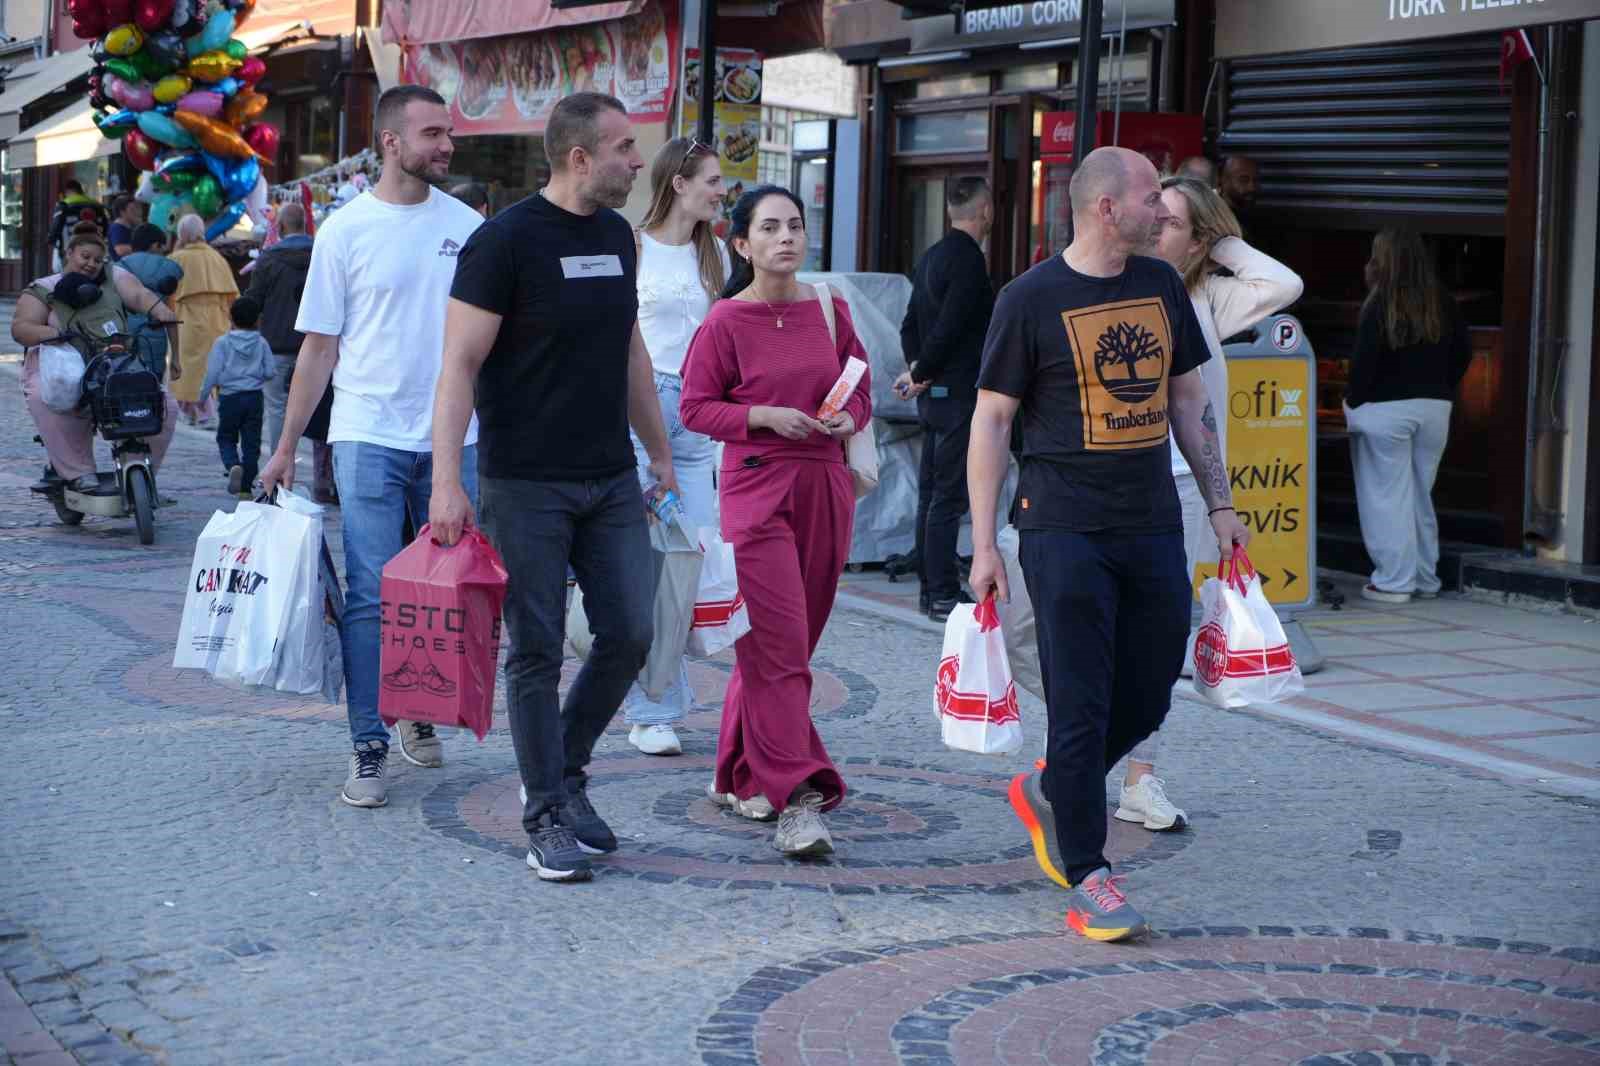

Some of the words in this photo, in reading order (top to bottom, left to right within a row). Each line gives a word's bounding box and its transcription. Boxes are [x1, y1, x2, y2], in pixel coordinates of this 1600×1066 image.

[966, 4, 1024, 34] BRAND
[1031, 0, 1081, 25] CORN
[1227, 457, 1302, 490] KNİK
